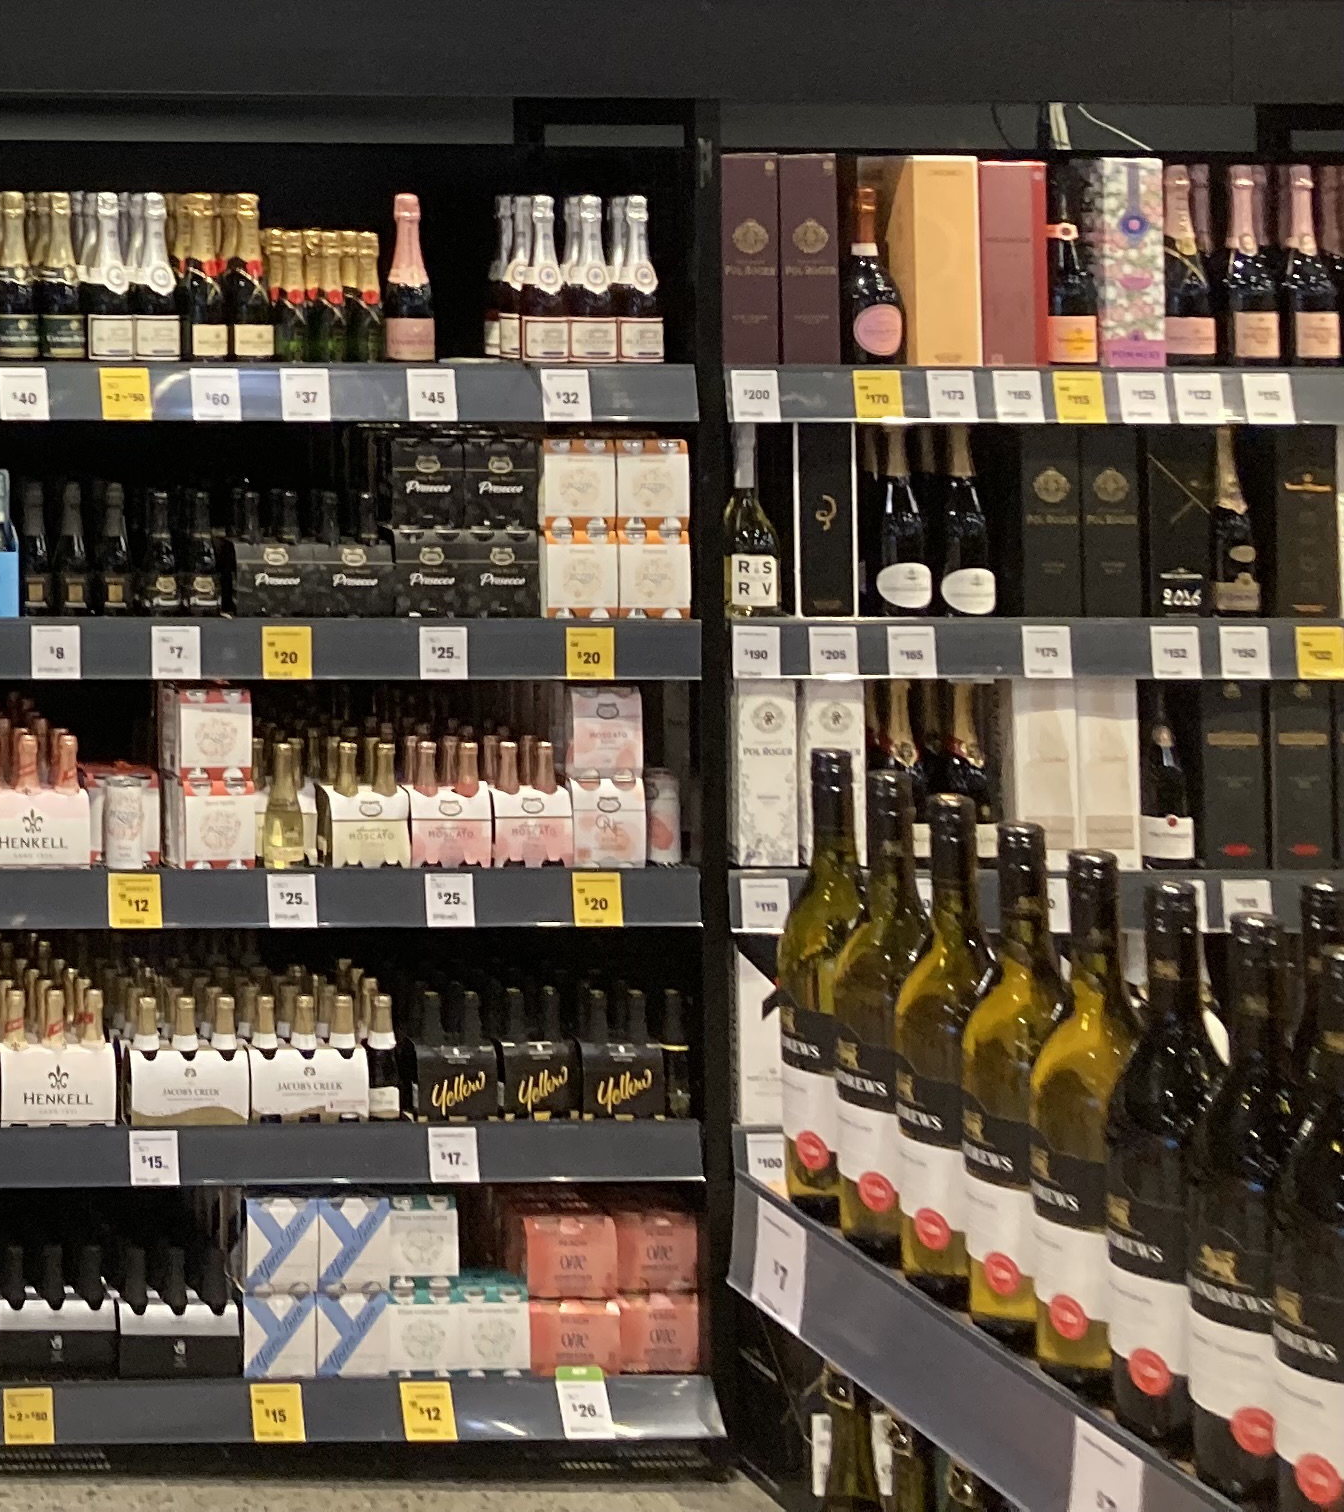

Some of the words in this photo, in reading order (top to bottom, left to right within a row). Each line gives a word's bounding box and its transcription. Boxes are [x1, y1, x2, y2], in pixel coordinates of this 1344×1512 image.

[11, 391, 37, 405] $40
[295, 390, 318, 404] $37
[421, 390, 446, 404] $45
[556, 391, 580, 405] $32
[254, 573, 301, 587] Prosecco
[332, 573, 378, 587] Prosecco
[409, 572, 455, 586] Prosecco
[480, 572, 526, 586] Prosecco
[169, 645, 184, 659] $7
[274, 650, 298, 664] $20
[431, 645, 455, 660] $25
[577, 650, 601, 665] $20
[349, 831, 395, 842] MOSCATO
[428, 828, 474, 839] MOSCATO
[128, 898, 150, 912] $12
[280, 891, 303, 905] $25
[437, 891, 461, 905] $25
[584, 897, 609, 911] $20
[431, 1070, 486, 1117] Yellow
[518, 1066, 568, 1113] Yellow
[597, 1069, 652, 1115] Yellow
[23, 1092, 93, 1106] HENKELL
[141, 1154, 163, 1169] $15
[440, 1151, 461, 1166] $17
[264, 1409, 287, 1423] $15
[419, 1407, 442, 1422] $12
